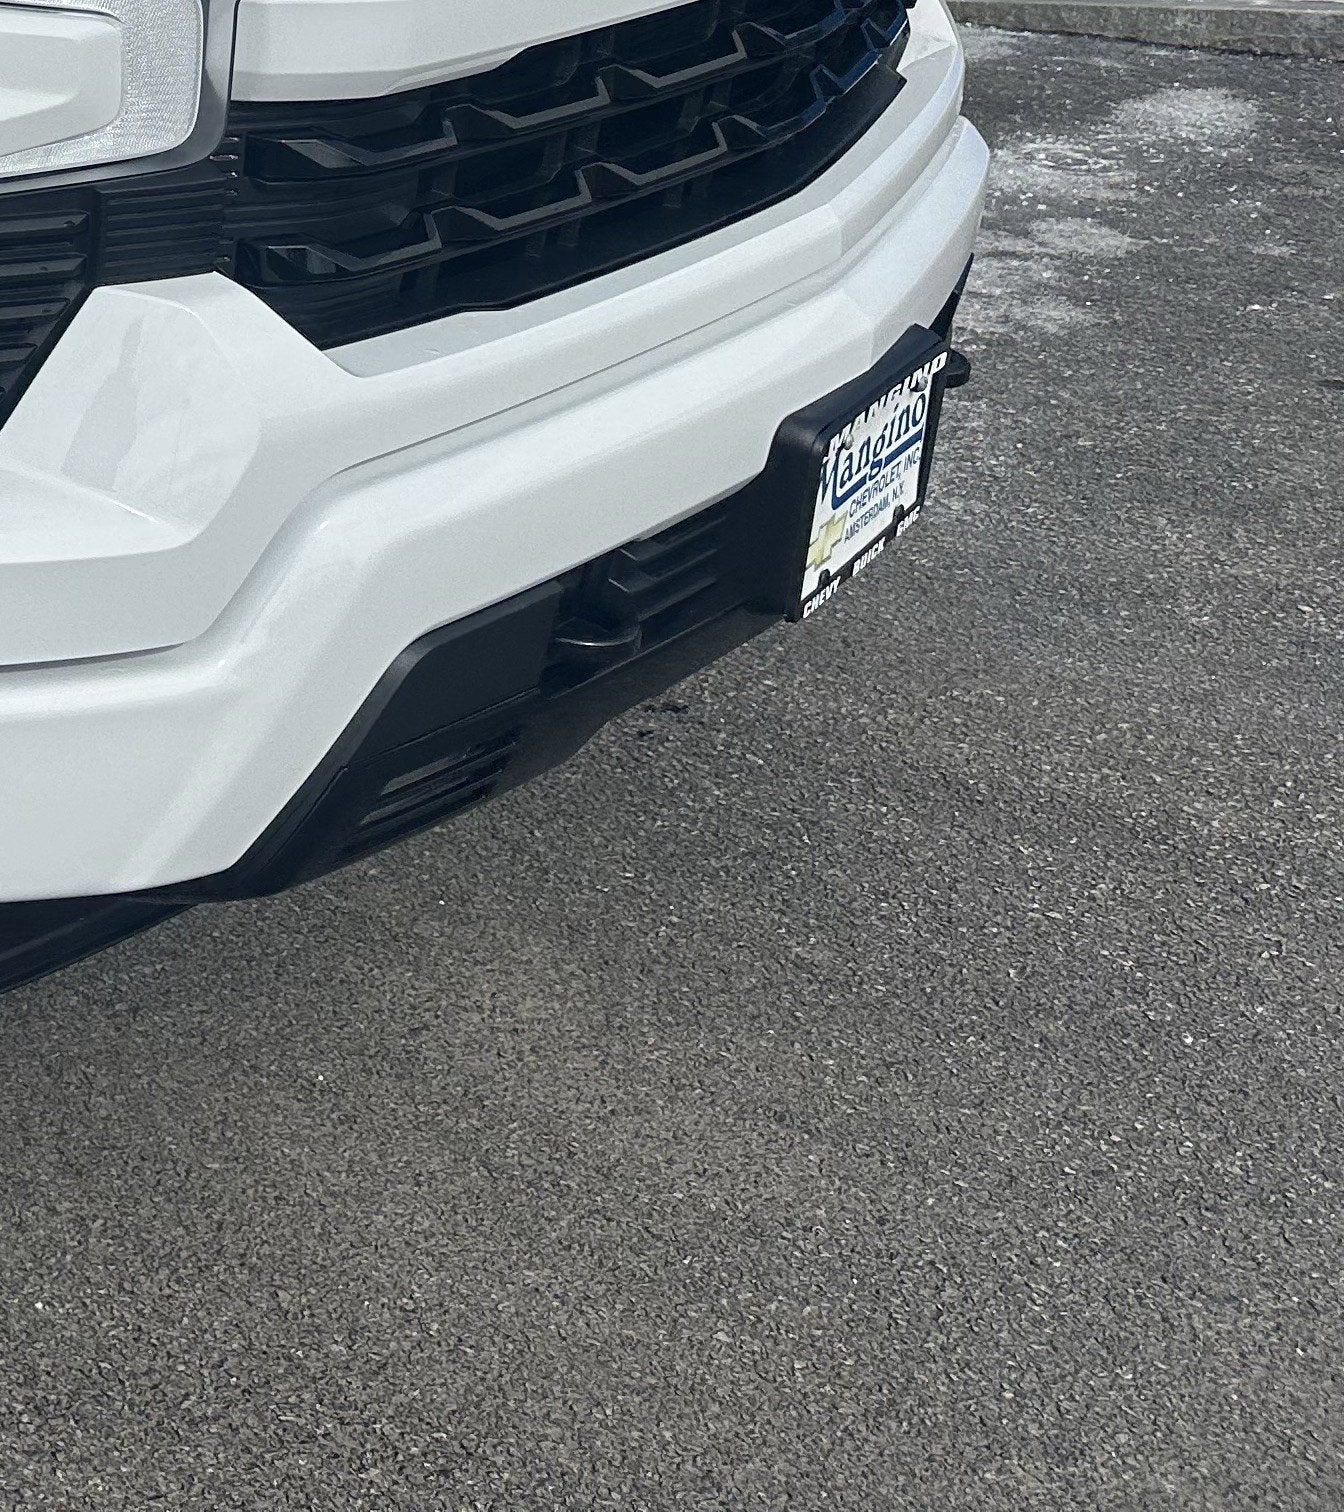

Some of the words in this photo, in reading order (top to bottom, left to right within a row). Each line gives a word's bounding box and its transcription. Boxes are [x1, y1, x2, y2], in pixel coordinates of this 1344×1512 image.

[818, 392, 926, 510] Mangino
[803, 576, 841, 619] CHEVY
[852, 537, 886, 577] BUICK
[896, 505, 921, 537] GMC
